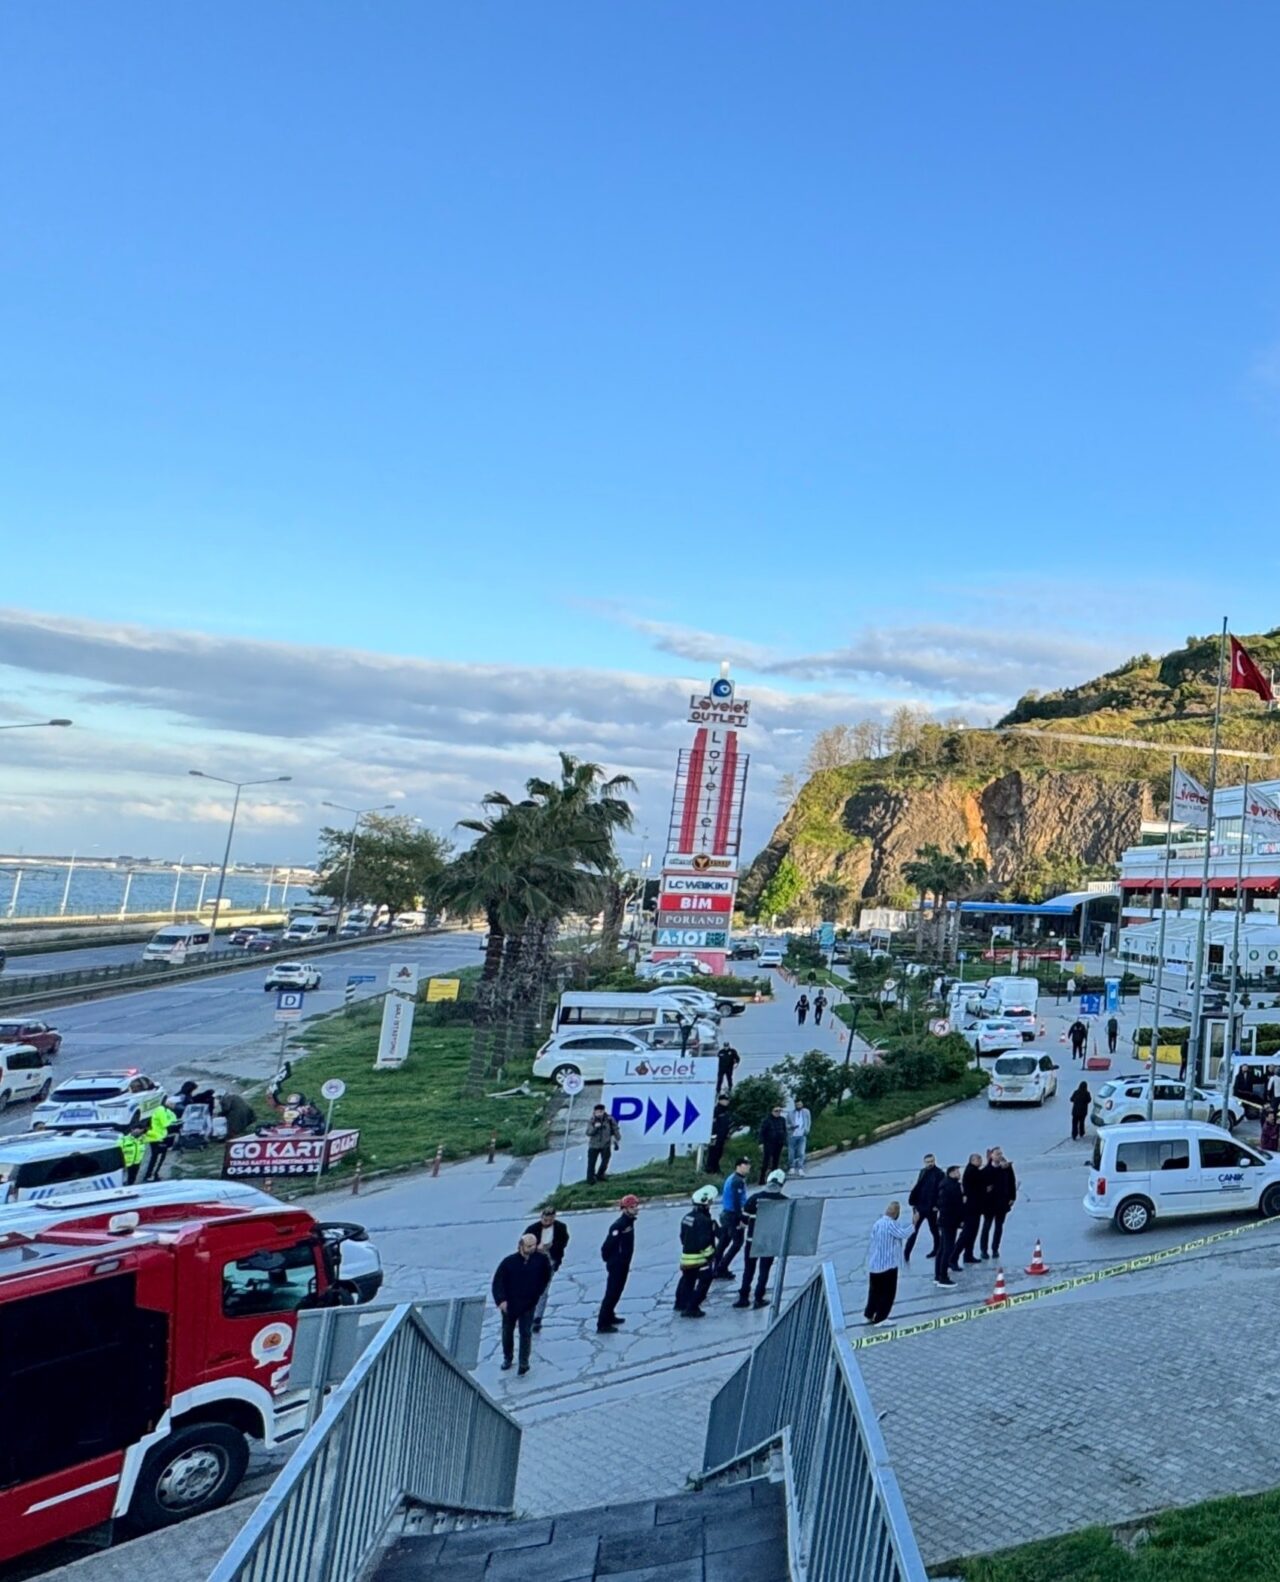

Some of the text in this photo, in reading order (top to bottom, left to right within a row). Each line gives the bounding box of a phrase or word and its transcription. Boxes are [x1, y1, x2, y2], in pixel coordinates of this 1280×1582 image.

[690, 695, 749, 714] Lovelet
[691, 711, 746, 724] OUTLET
[668, 880, 684, 889] LC
[665, 915, 725, 925] PORLAND
[624, 1060, 697, 1076] Lovelet
[611, 1096, 644, 1123] P
[229, 1141, 325, 1159] GO KART
[227, 1166, 260, 1175] 0544
[288, 1165, 304, 1173] 56
